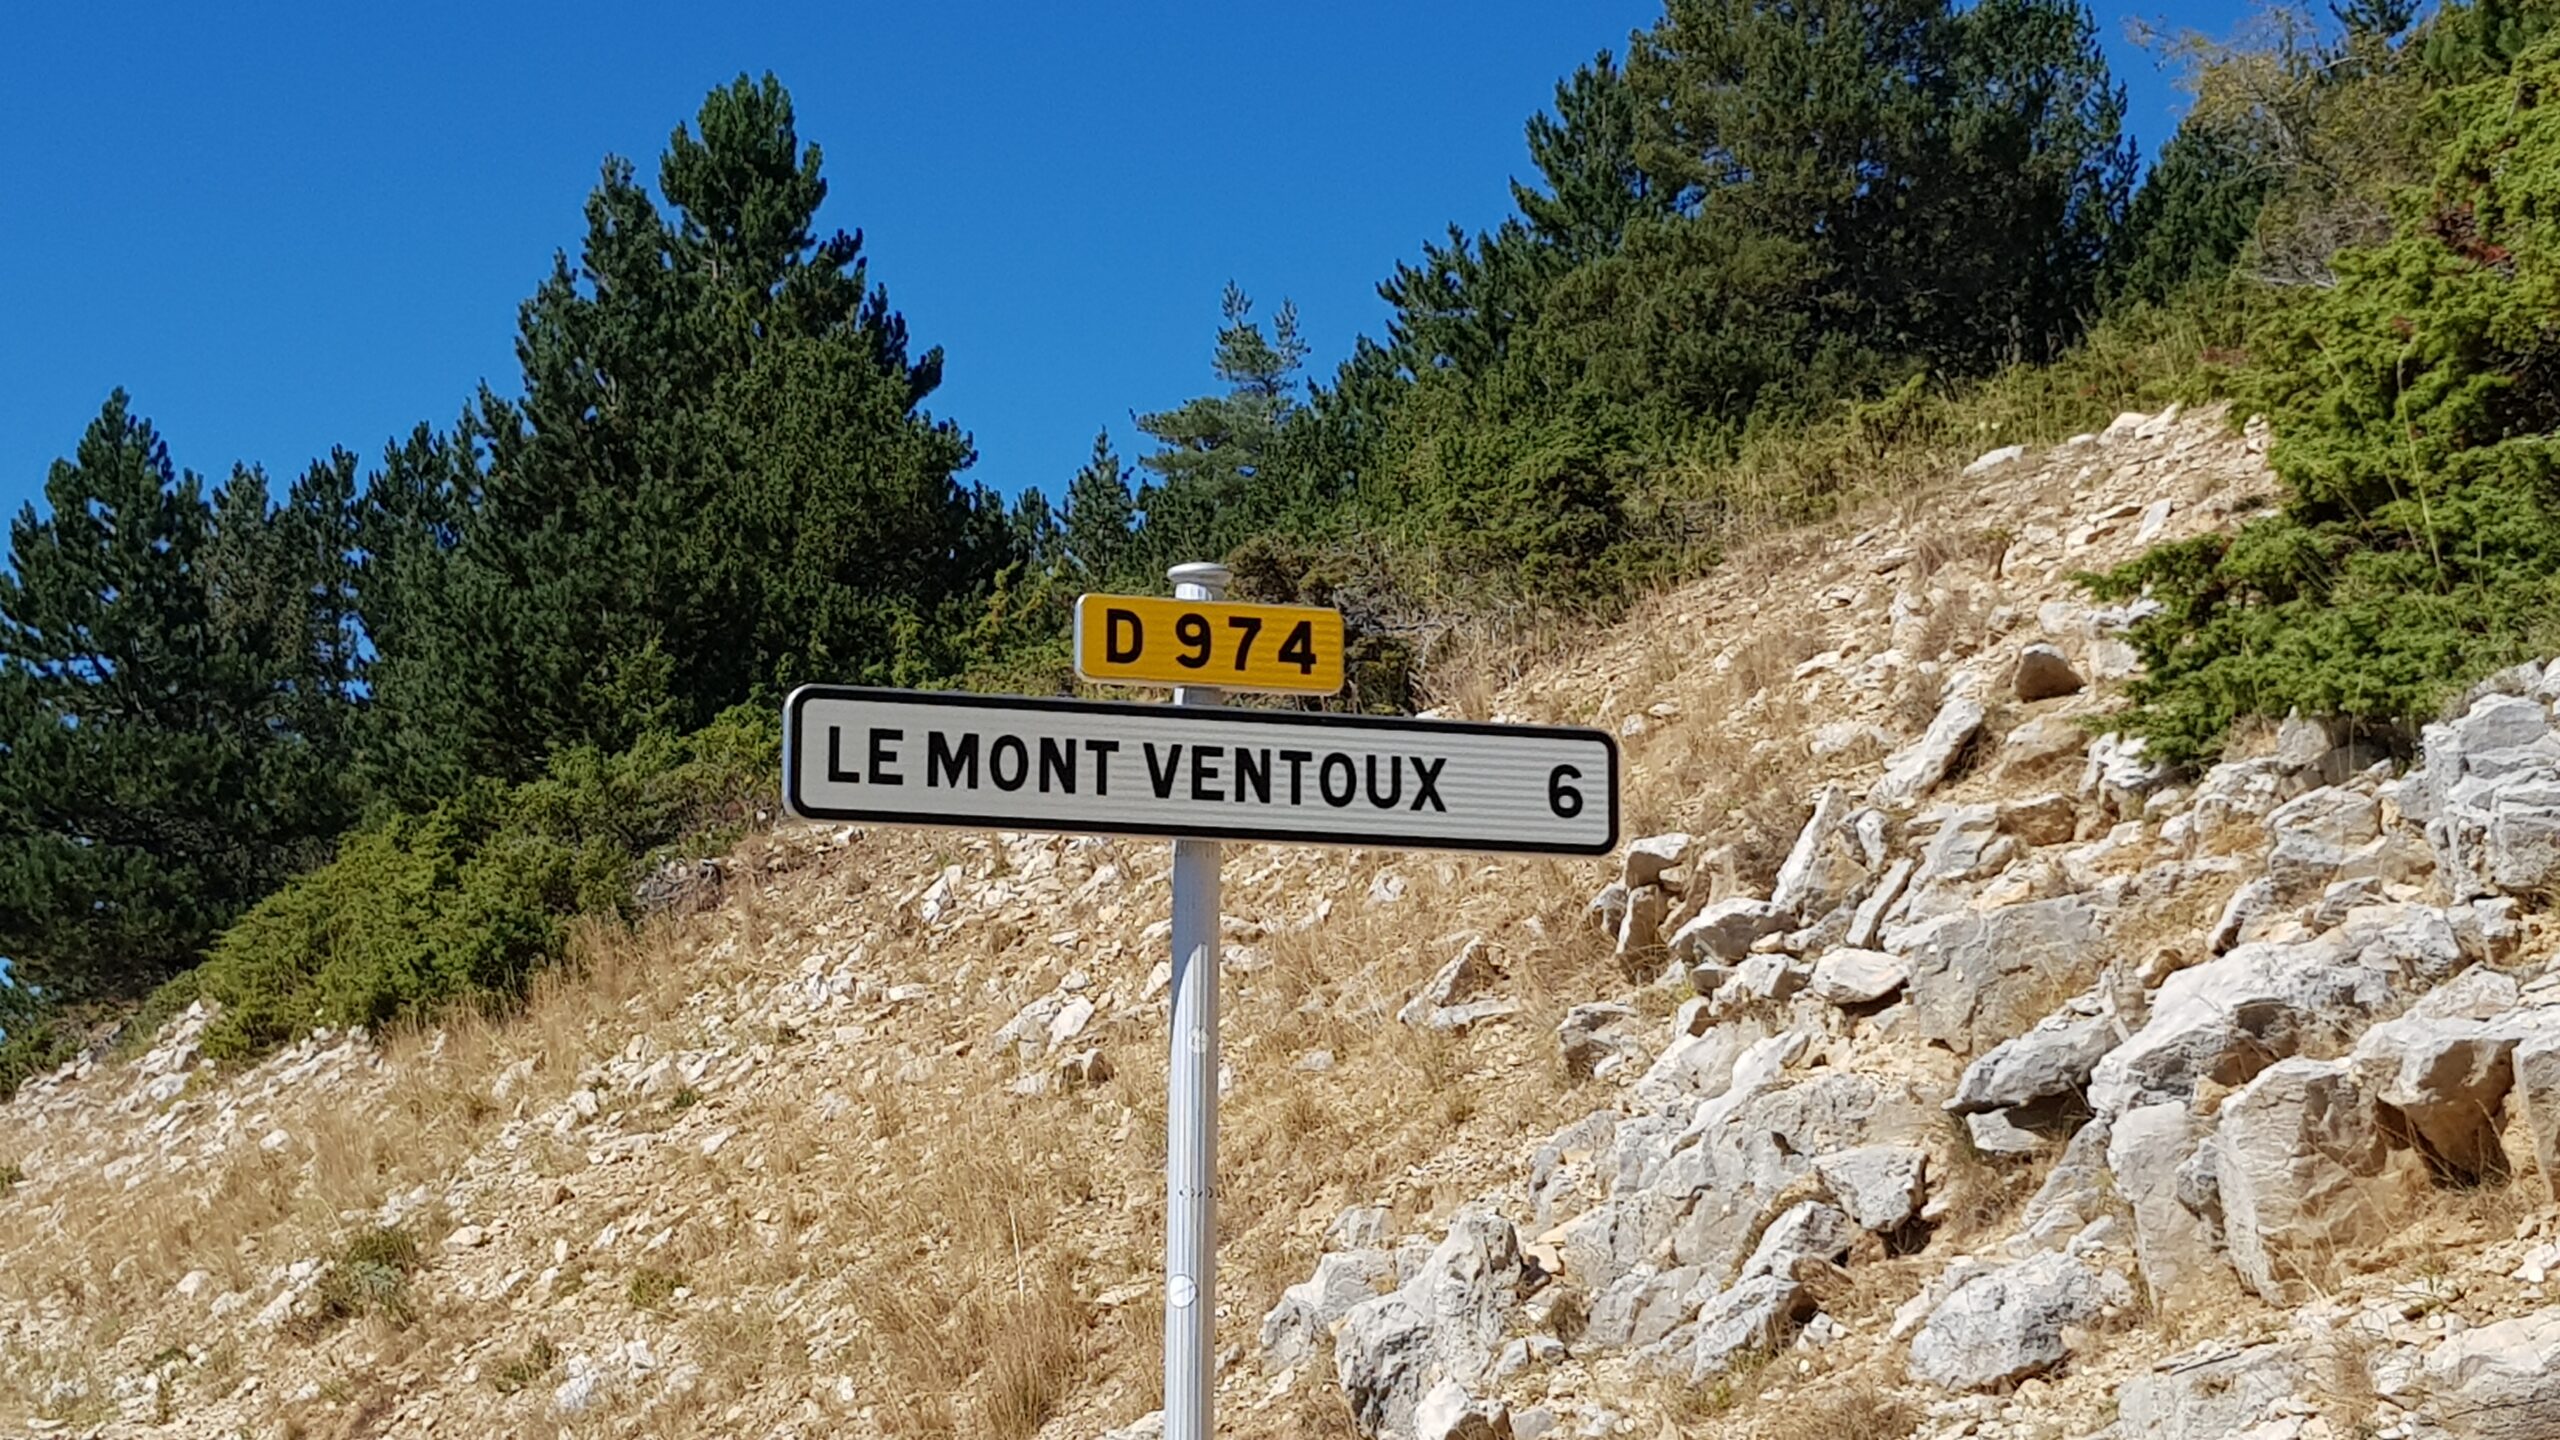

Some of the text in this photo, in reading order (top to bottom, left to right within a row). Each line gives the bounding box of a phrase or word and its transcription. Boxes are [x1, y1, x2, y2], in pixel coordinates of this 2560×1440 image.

[1105, 607, 1318, 676] D 974
[827, 725, 1584, 819] LE MONT VENTOUX 6
